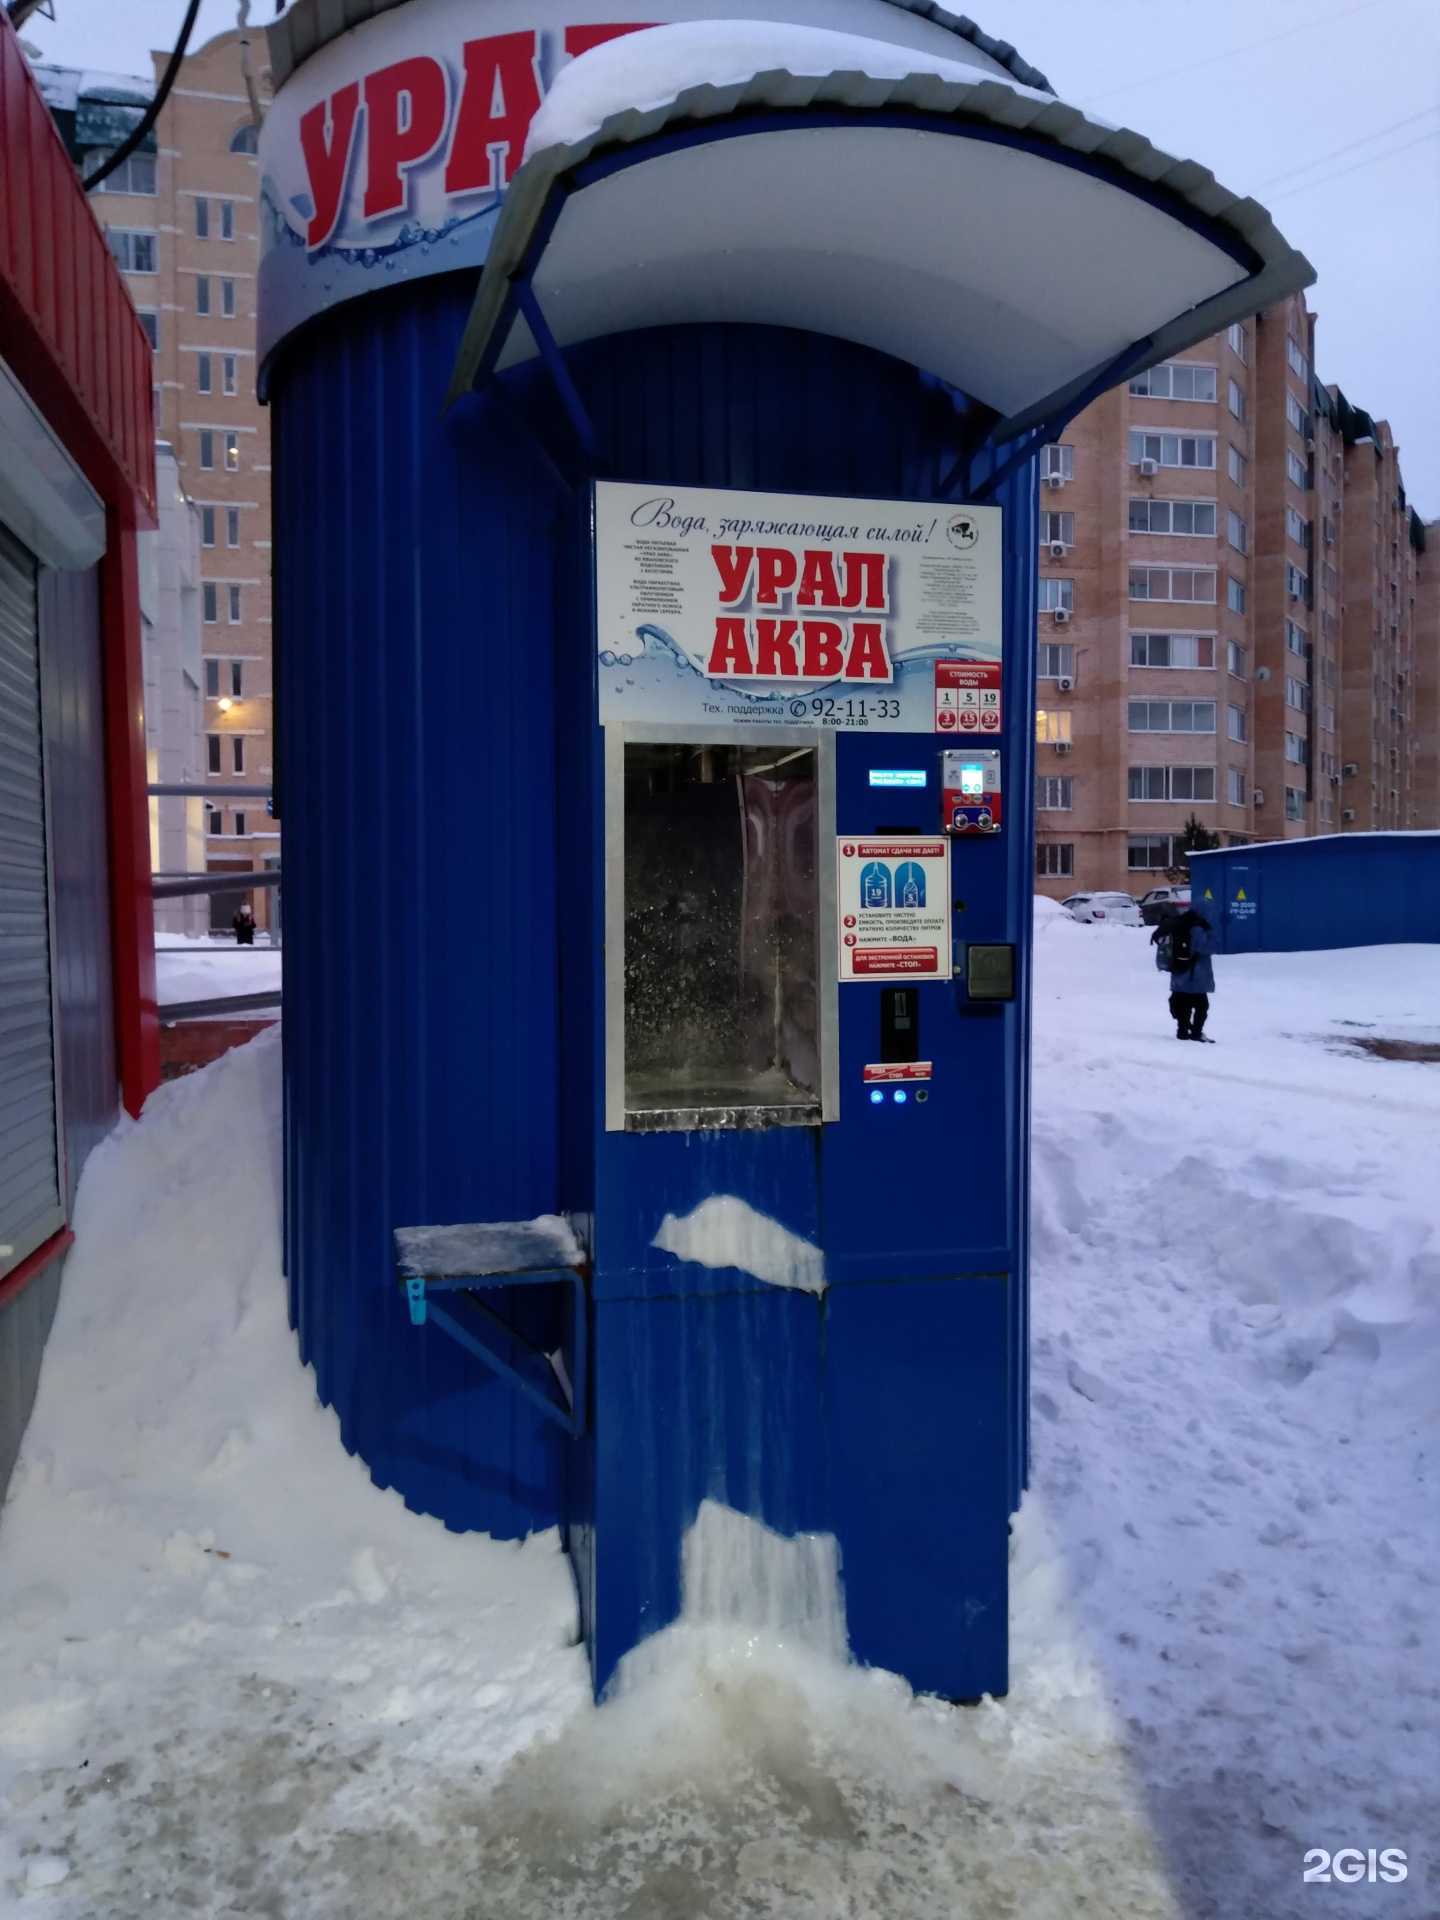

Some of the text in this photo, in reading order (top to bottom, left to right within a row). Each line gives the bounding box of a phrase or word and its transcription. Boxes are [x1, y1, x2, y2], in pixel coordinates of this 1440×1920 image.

[630, 497, 709, 538] Вода,
[712, 515, 858, 541] заряжающая
[866, 518, 937, 543] силой!
[711, 544, 885, 609] УРАЛ
[708, 617, 889, 679] АКВА
[703, 698, 901, 719] Тех. поддержка 92-11-33
[944, 692, 996, 703] 1 5 19
[862, 846, 889, 855] АВТОМАТ
[891, 846, 912, 856] СДАЧИ
[913, 846, 921, 855] НЕ
